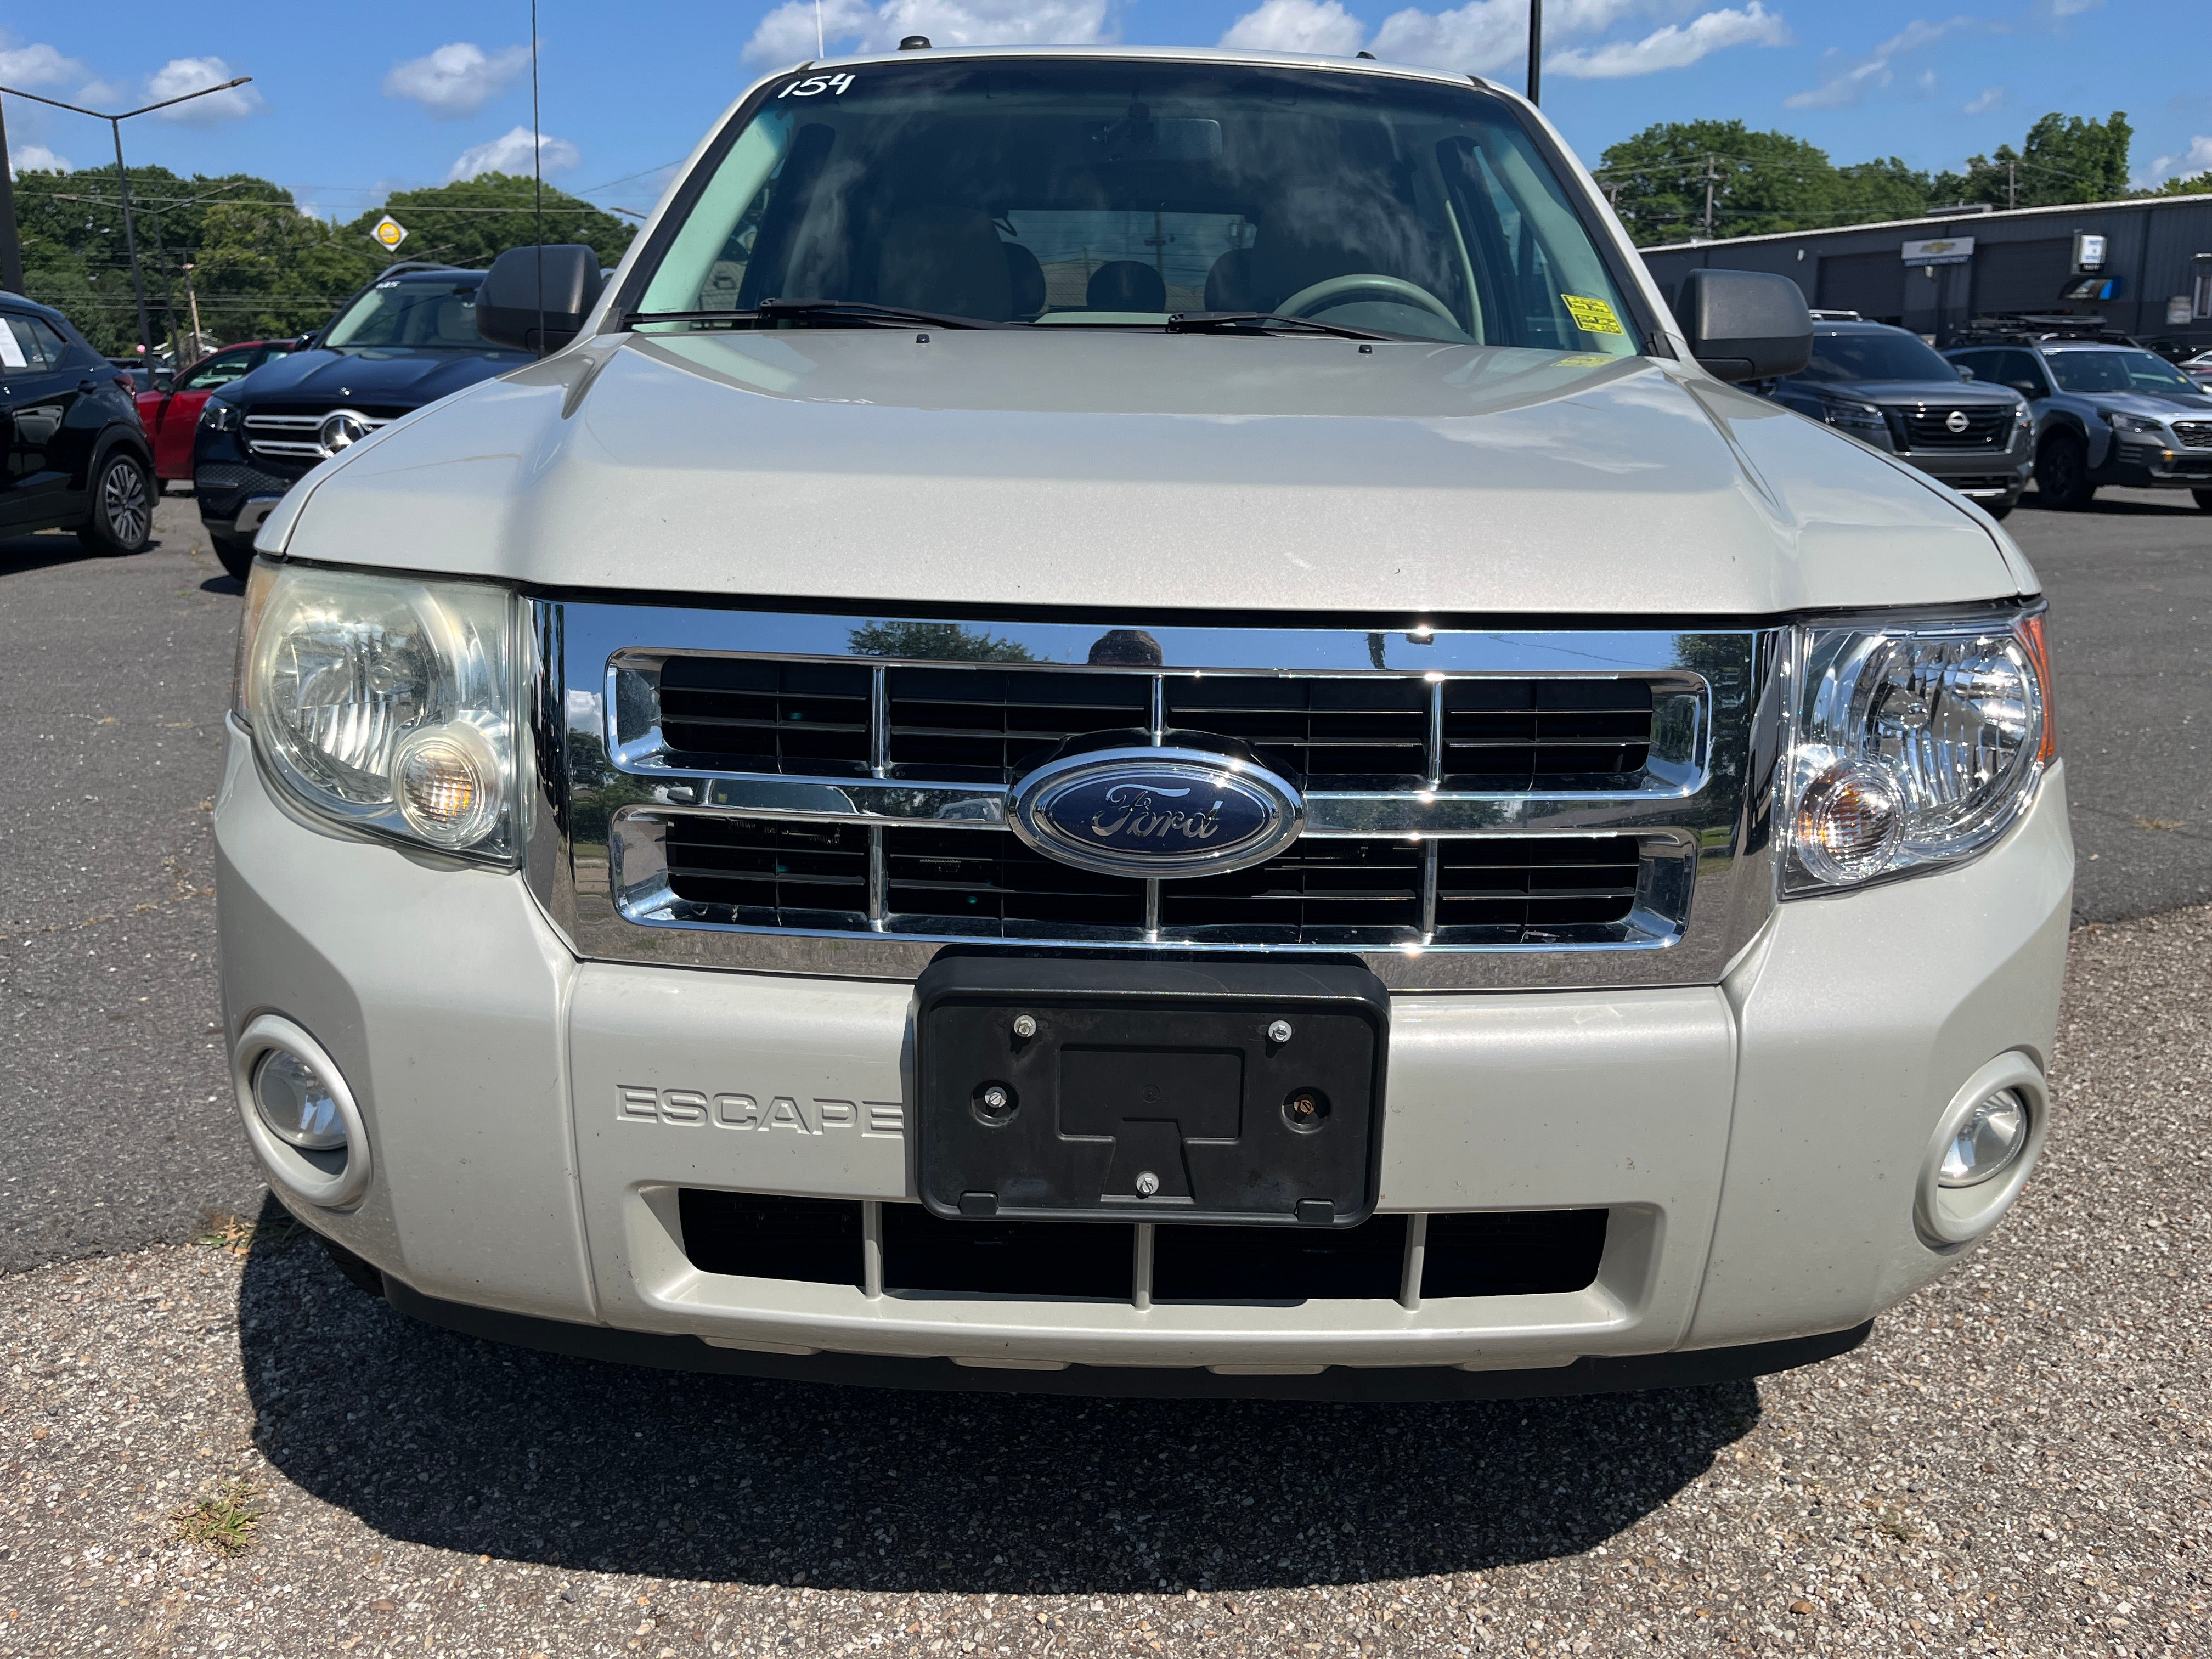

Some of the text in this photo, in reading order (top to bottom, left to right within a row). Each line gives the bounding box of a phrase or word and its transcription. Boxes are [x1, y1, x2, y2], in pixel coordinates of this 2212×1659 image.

[778, 73, 856, 98] 154
[1092, 784, 1223, 838] Ford
[616, 1084, 904, 1139] ESCAPE
